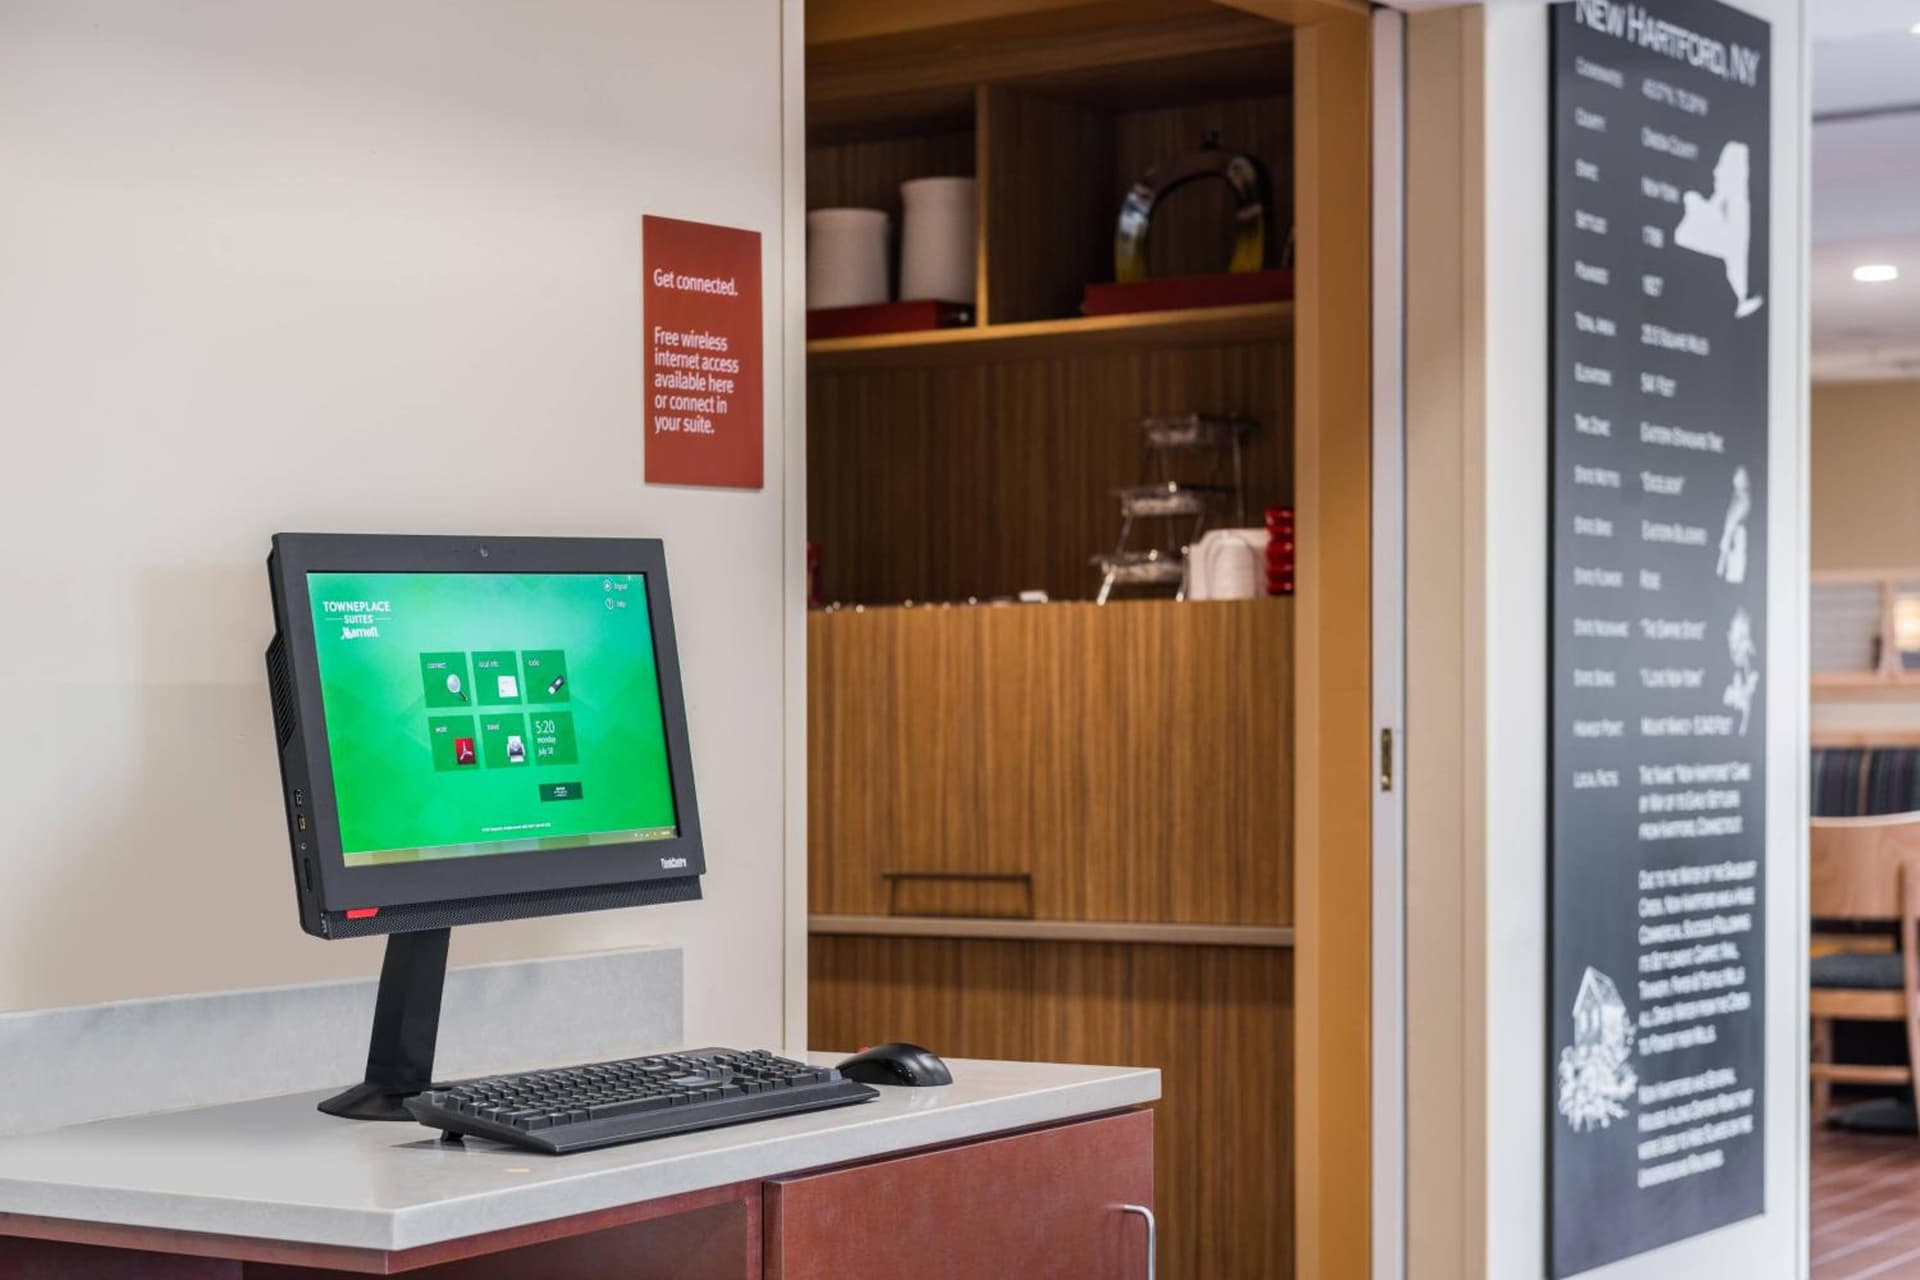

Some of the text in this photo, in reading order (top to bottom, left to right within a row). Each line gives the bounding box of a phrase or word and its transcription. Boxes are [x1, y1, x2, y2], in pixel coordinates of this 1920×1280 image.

[1730, 42, 1761, 88] NY
[653, 268, 739, 297] Get connected.
[654, 326, 728, 352] Free wireless
[654, 347, 740, 374] internet access
[654, 370, 735, 394] available here
[654, 394, 727, 414] or connect in
[654, 414, 715, 434] your suite.
[322, 600, 391, 613] TOWNEPLACE
[343, 613, 374, 624] SUITES
[535, 719, 556, 736] 5:20
